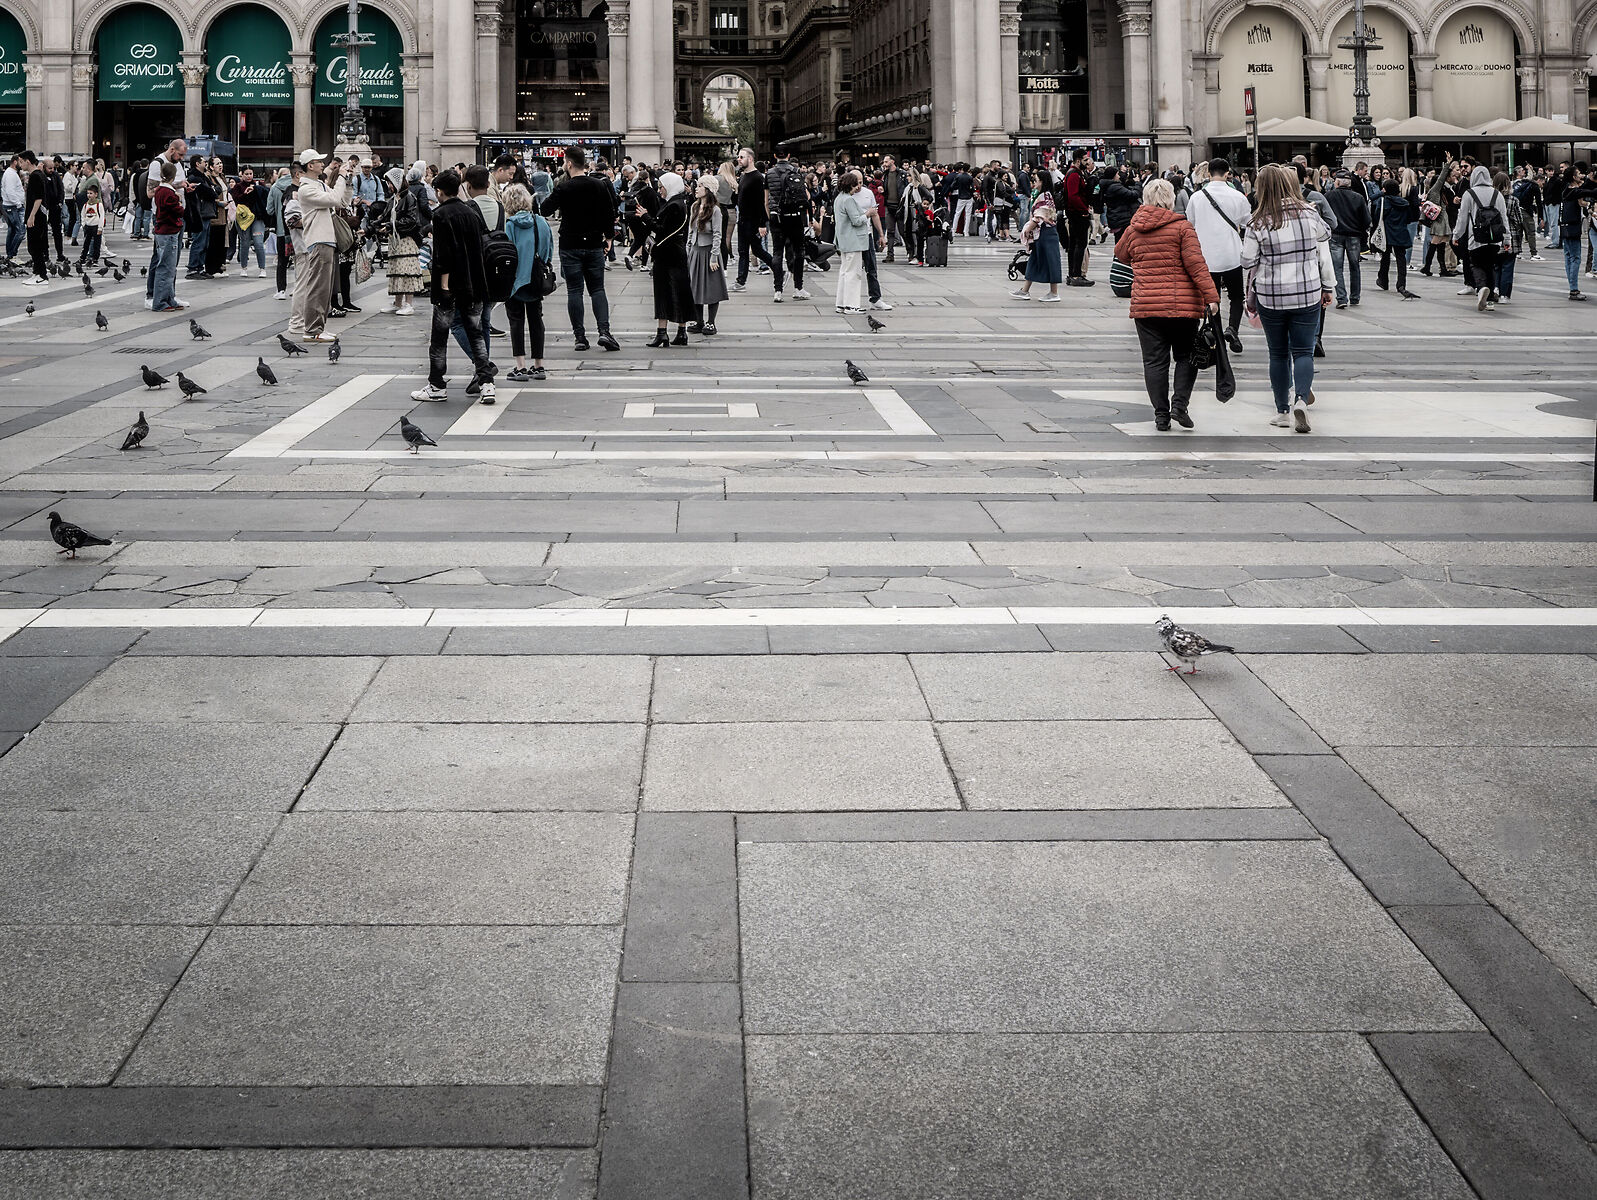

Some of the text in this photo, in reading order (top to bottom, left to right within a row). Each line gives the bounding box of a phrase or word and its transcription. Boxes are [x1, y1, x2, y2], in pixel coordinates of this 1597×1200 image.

[530, 31, 597, 43] CAMPARINO
[114, 63, 174, 76] GRIMOLDI
[326, 56, 395, 84] Curado
[1247, 63, 1274, 73] Motta
[1026, 77, 1060, 90] Motta
